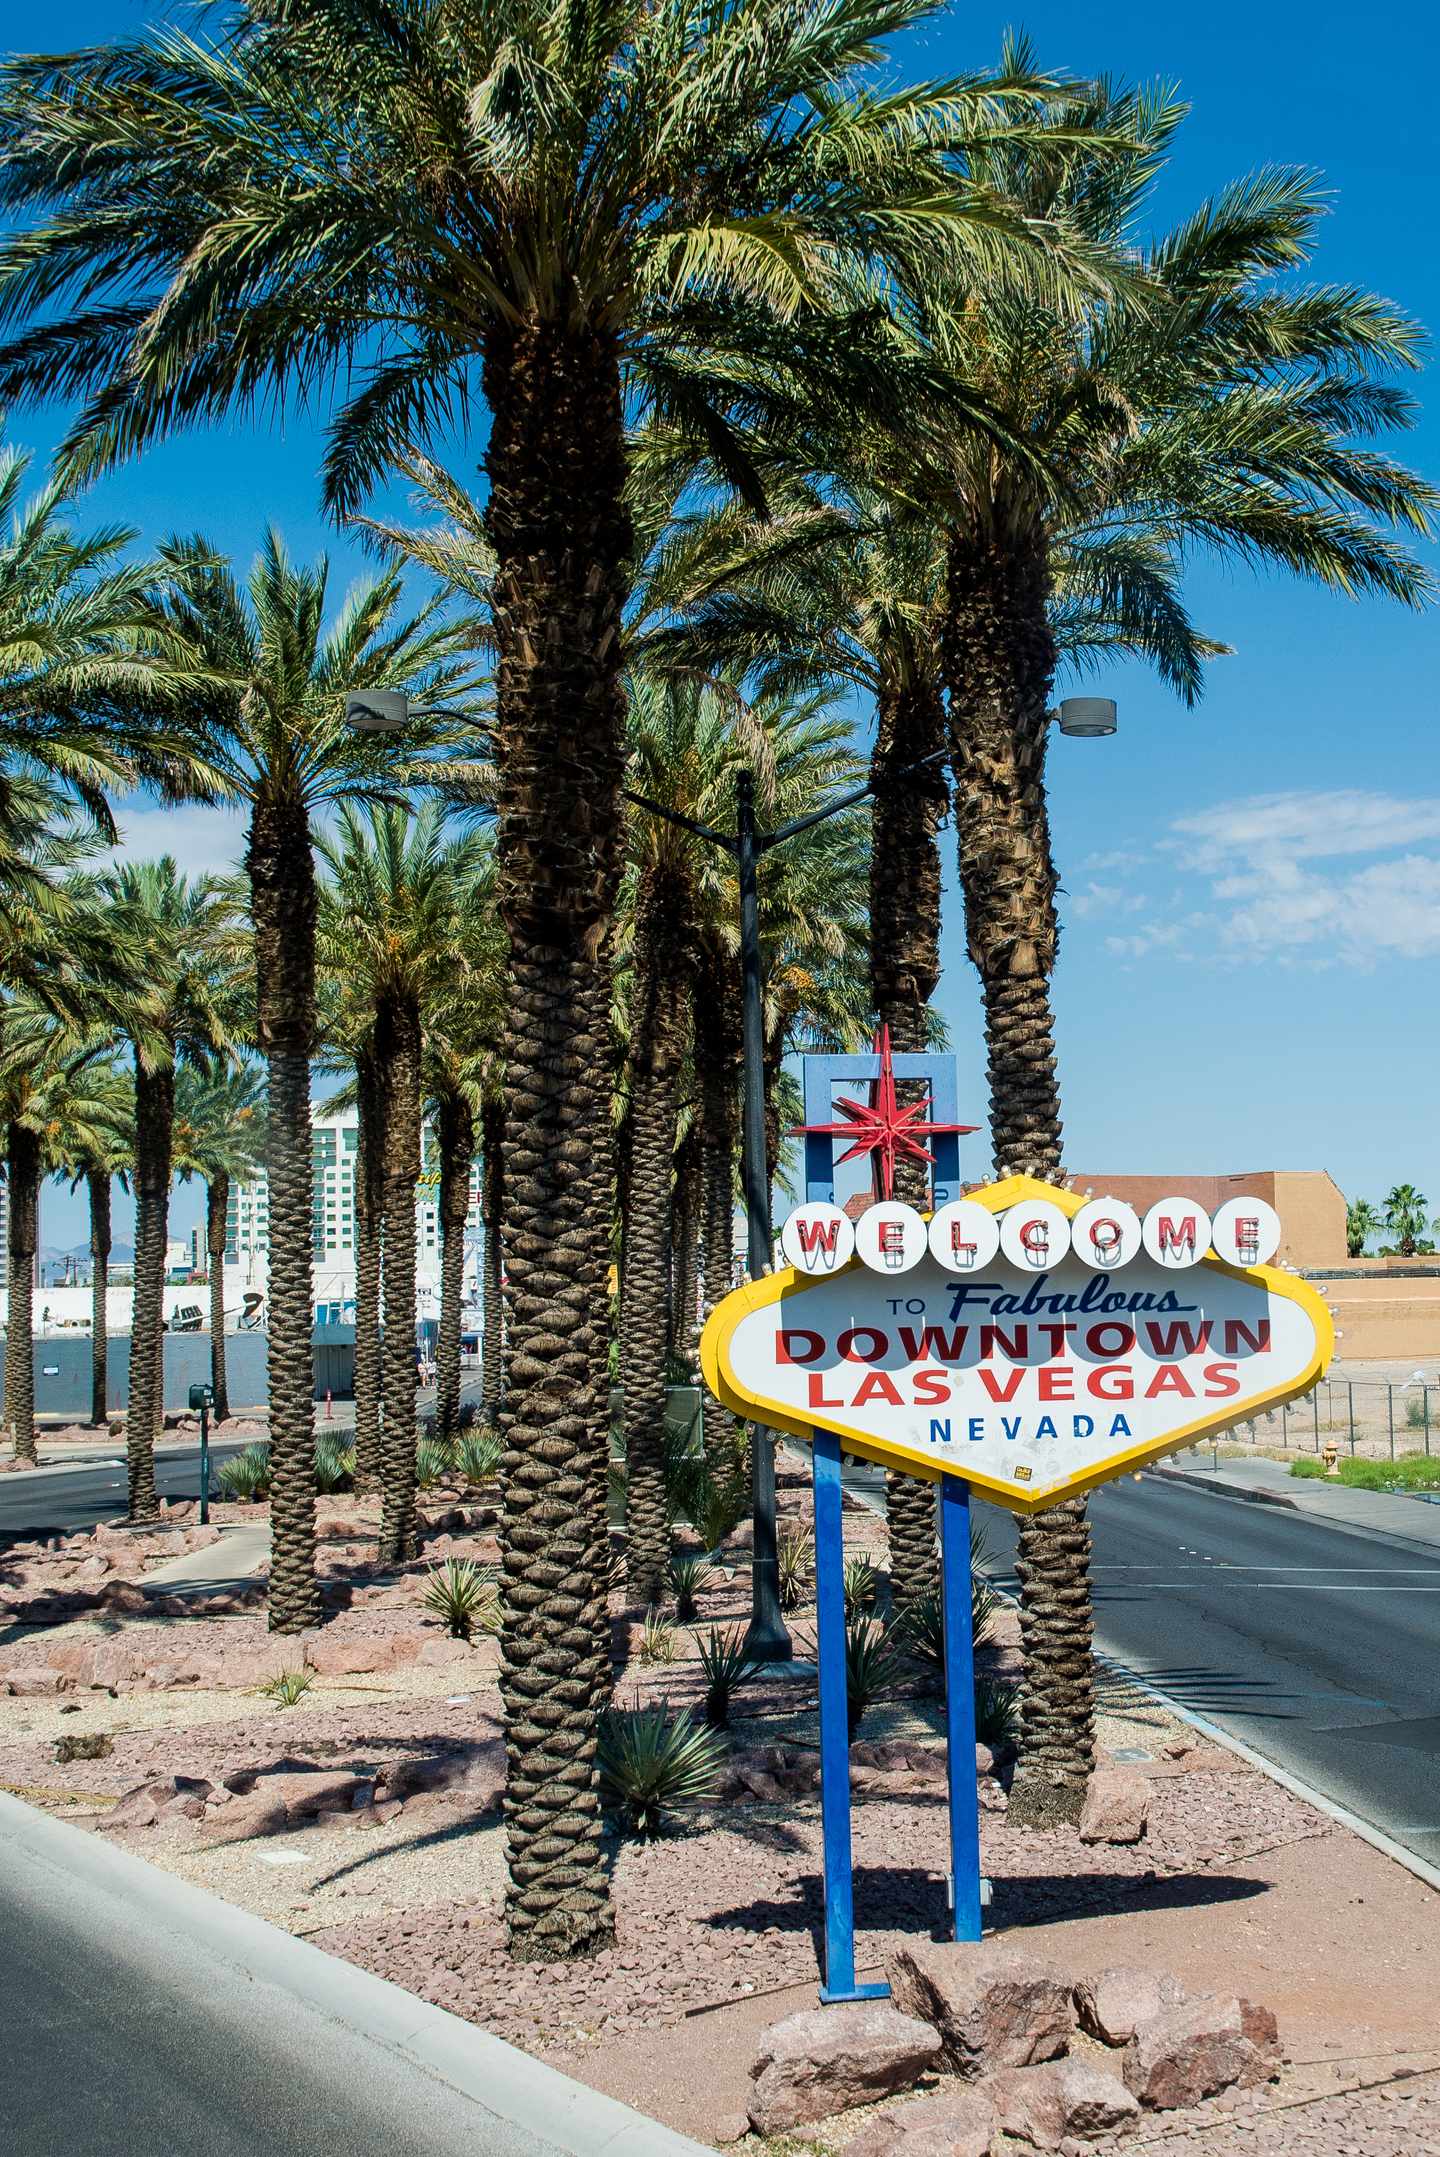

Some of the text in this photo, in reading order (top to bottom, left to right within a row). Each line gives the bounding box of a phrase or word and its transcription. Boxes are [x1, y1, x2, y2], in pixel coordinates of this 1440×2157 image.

[796, 1216, 1260, 1253] WELCOME
[886, 1273, 1198, 1323] TO Fabulous
[775, 1319, 1271, 1365] DOWNTOWN
[808, 1362, 1241, 1408] LAS VEGAS
[929, 1413, 1132, 1443] NEVADA
